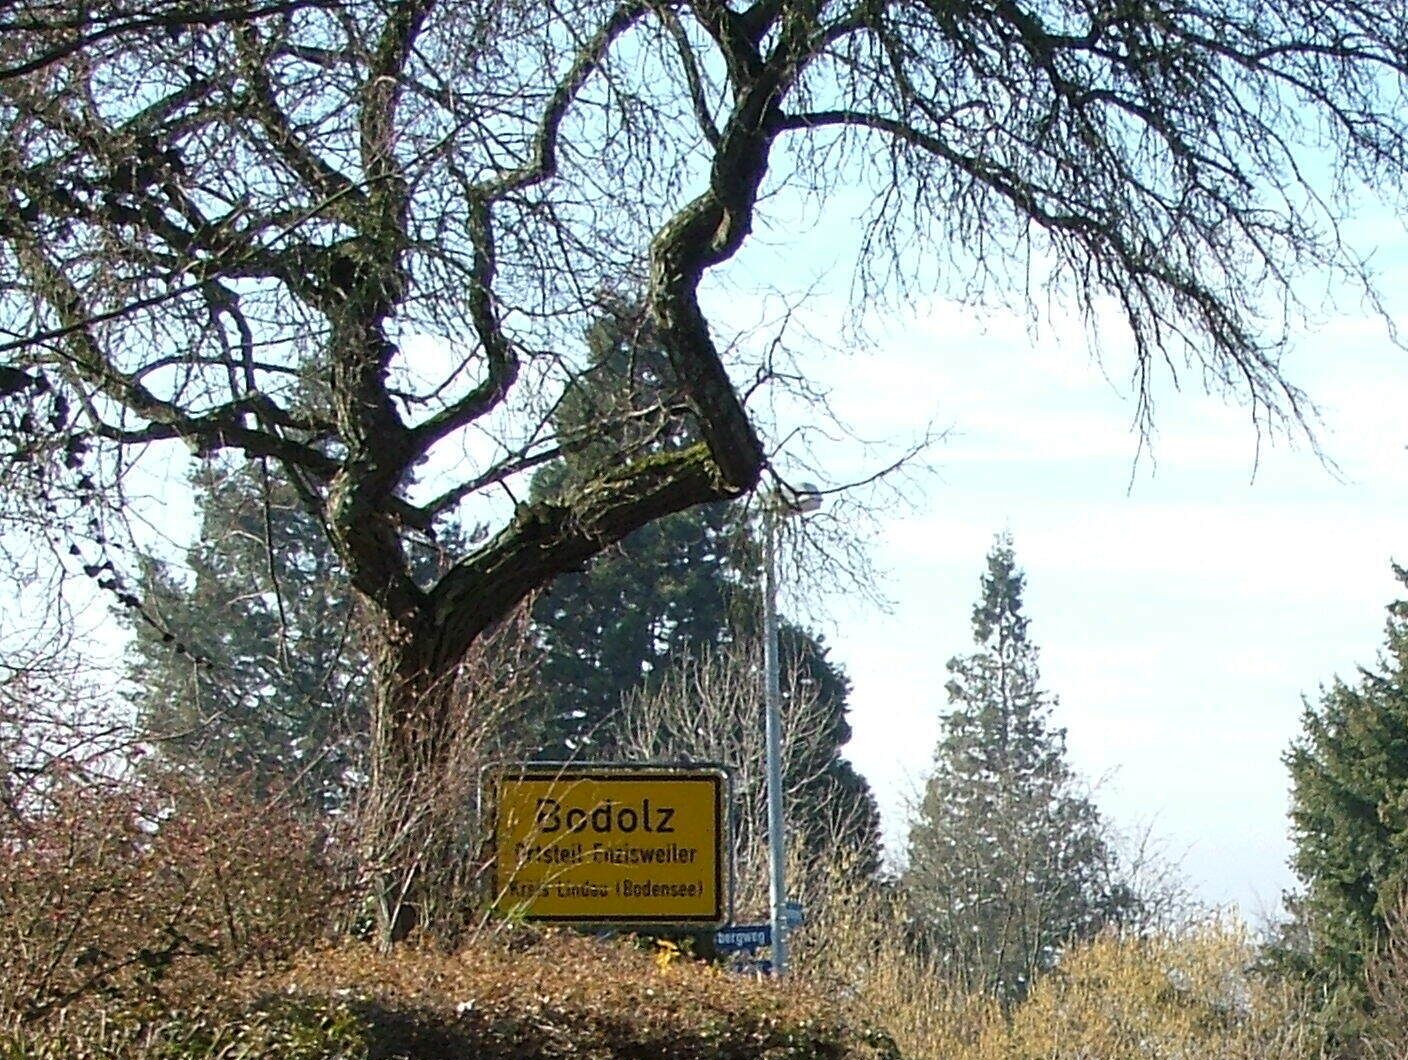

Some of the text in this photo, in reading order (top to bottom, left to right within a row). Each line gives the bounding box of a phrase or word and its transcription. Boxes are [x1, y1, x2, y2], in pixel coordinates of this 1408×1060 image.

[536, 798, 676, 834] Bodolz
[592, 842, 698, 864] Enzisweiler
[556, 879, 610, 898] Lindau
[615, 878, 704, 898] (Bodensee)
[717, 931, 766, 947] bergweg
